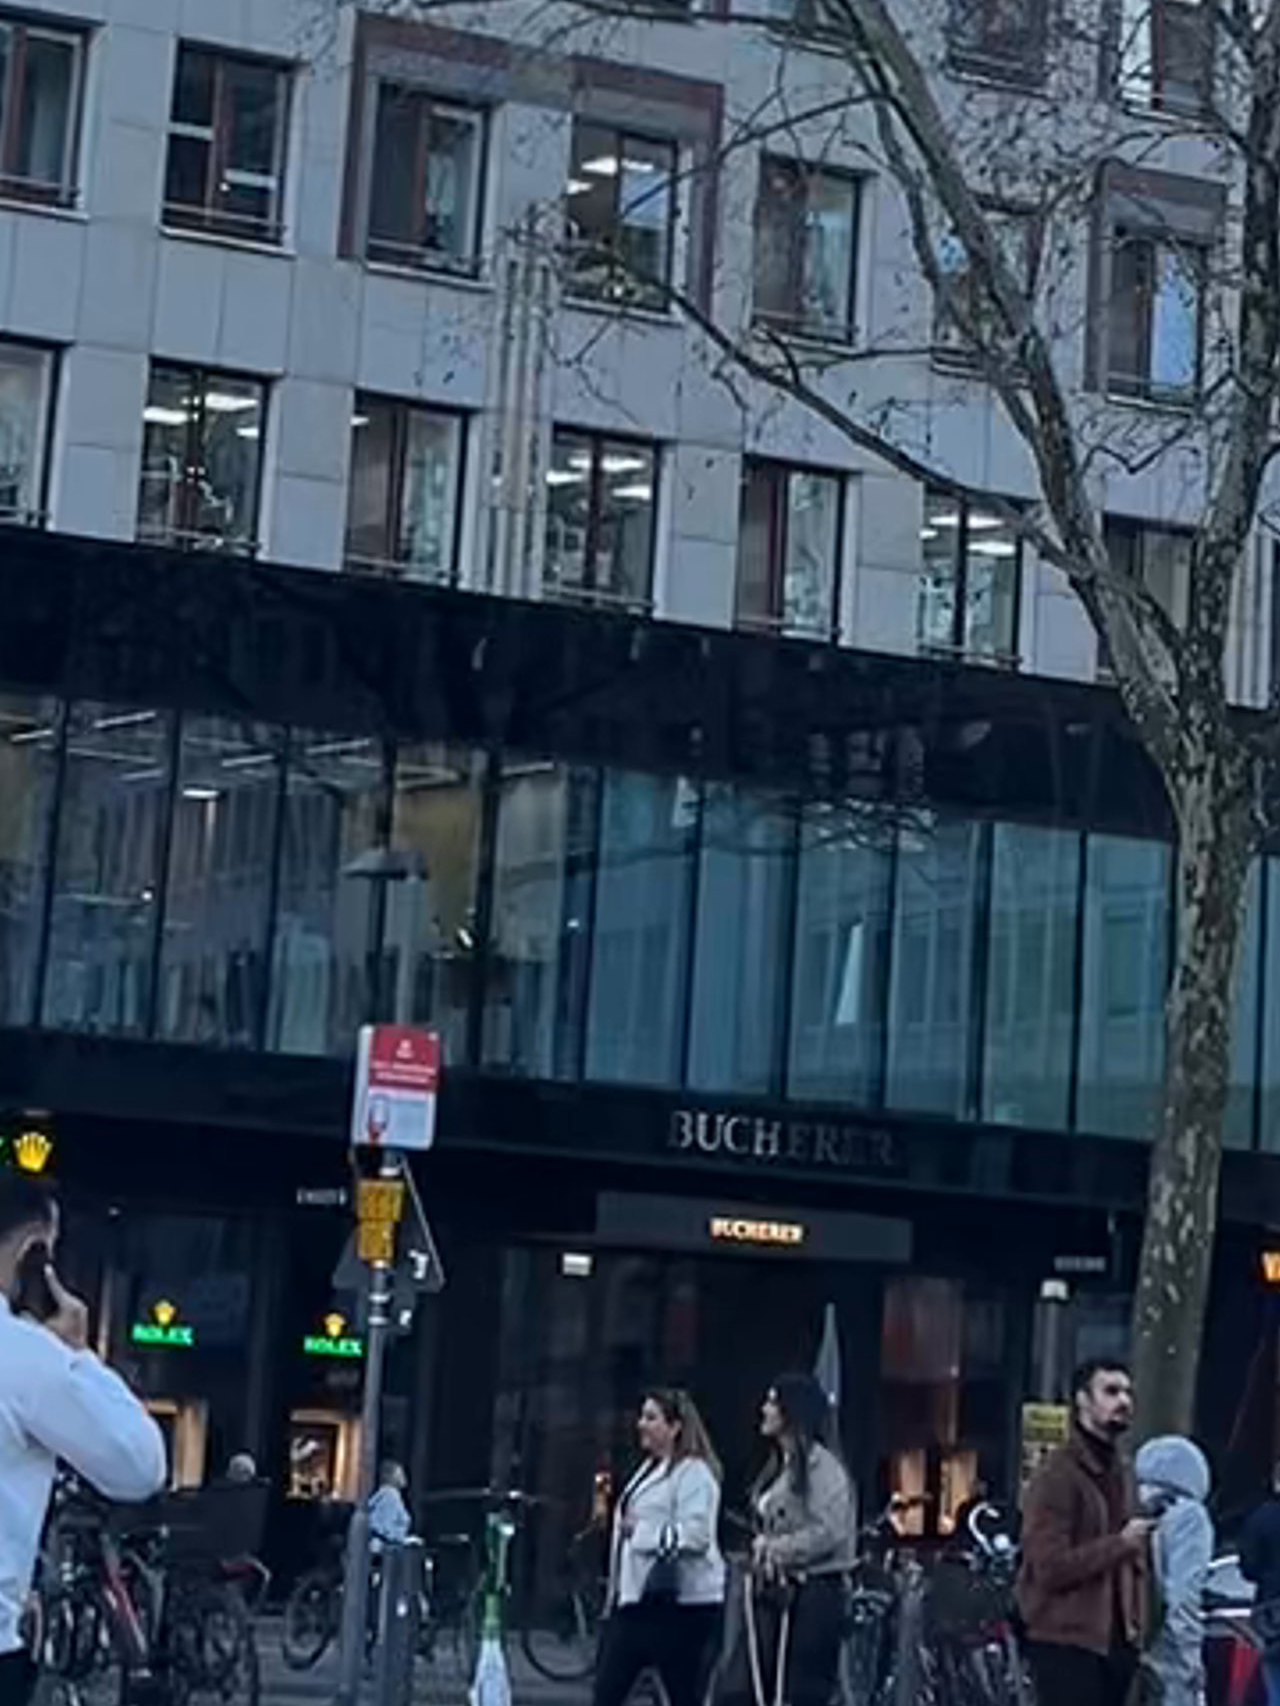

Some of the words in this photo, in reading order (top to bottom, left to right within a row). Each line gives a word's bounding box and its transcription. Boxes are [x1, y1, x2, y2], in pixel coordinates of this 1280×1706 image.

[668, 1108, 900, 1168] BUCHERER
[709, 1216, 804, 1245] BUCHERER
[131, 1323, 194, 1347] ROLEX
[302, 1336, 362, 1357] ROLEX
